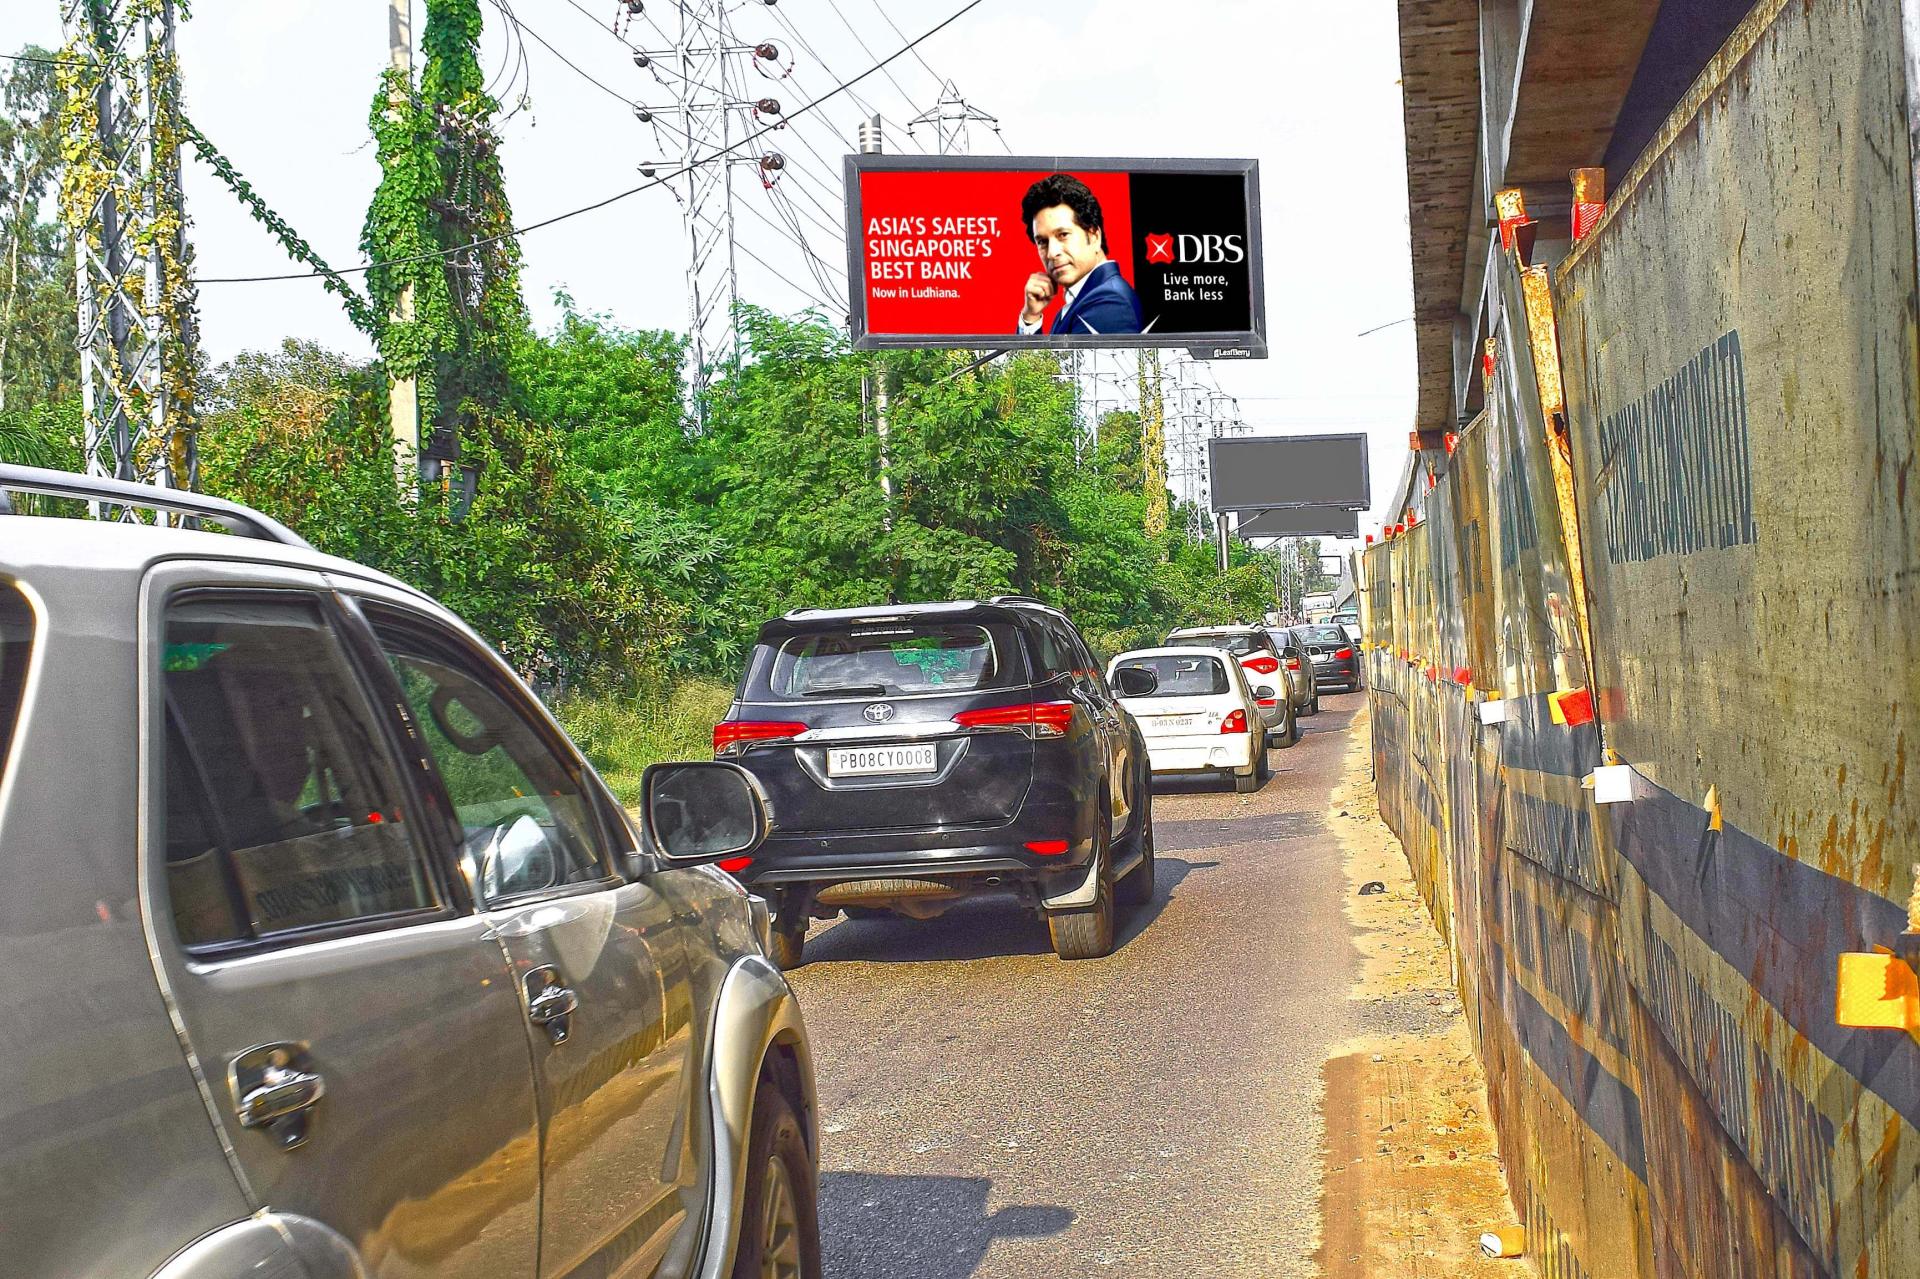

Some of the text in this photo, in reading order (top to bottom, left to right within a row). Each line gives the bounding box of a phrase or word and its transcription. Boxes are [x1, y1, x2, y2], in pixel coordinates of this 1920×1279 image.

[868, 216, 1001, 237] ASIA'S SAFEST,
[869, 238, 992, 257] SINGAPORE'S
[1177, 234, 1244, 263] DBS
[870, 261, 973, 280] BEST BANK
[1163, 272, 1229, 287] Live more,
[872, 287, 960, 299] Now in Ludhiana.
[1164, 288, 1224, 301] Bank less
[840, 749, 933, 769] PB08CY0008
